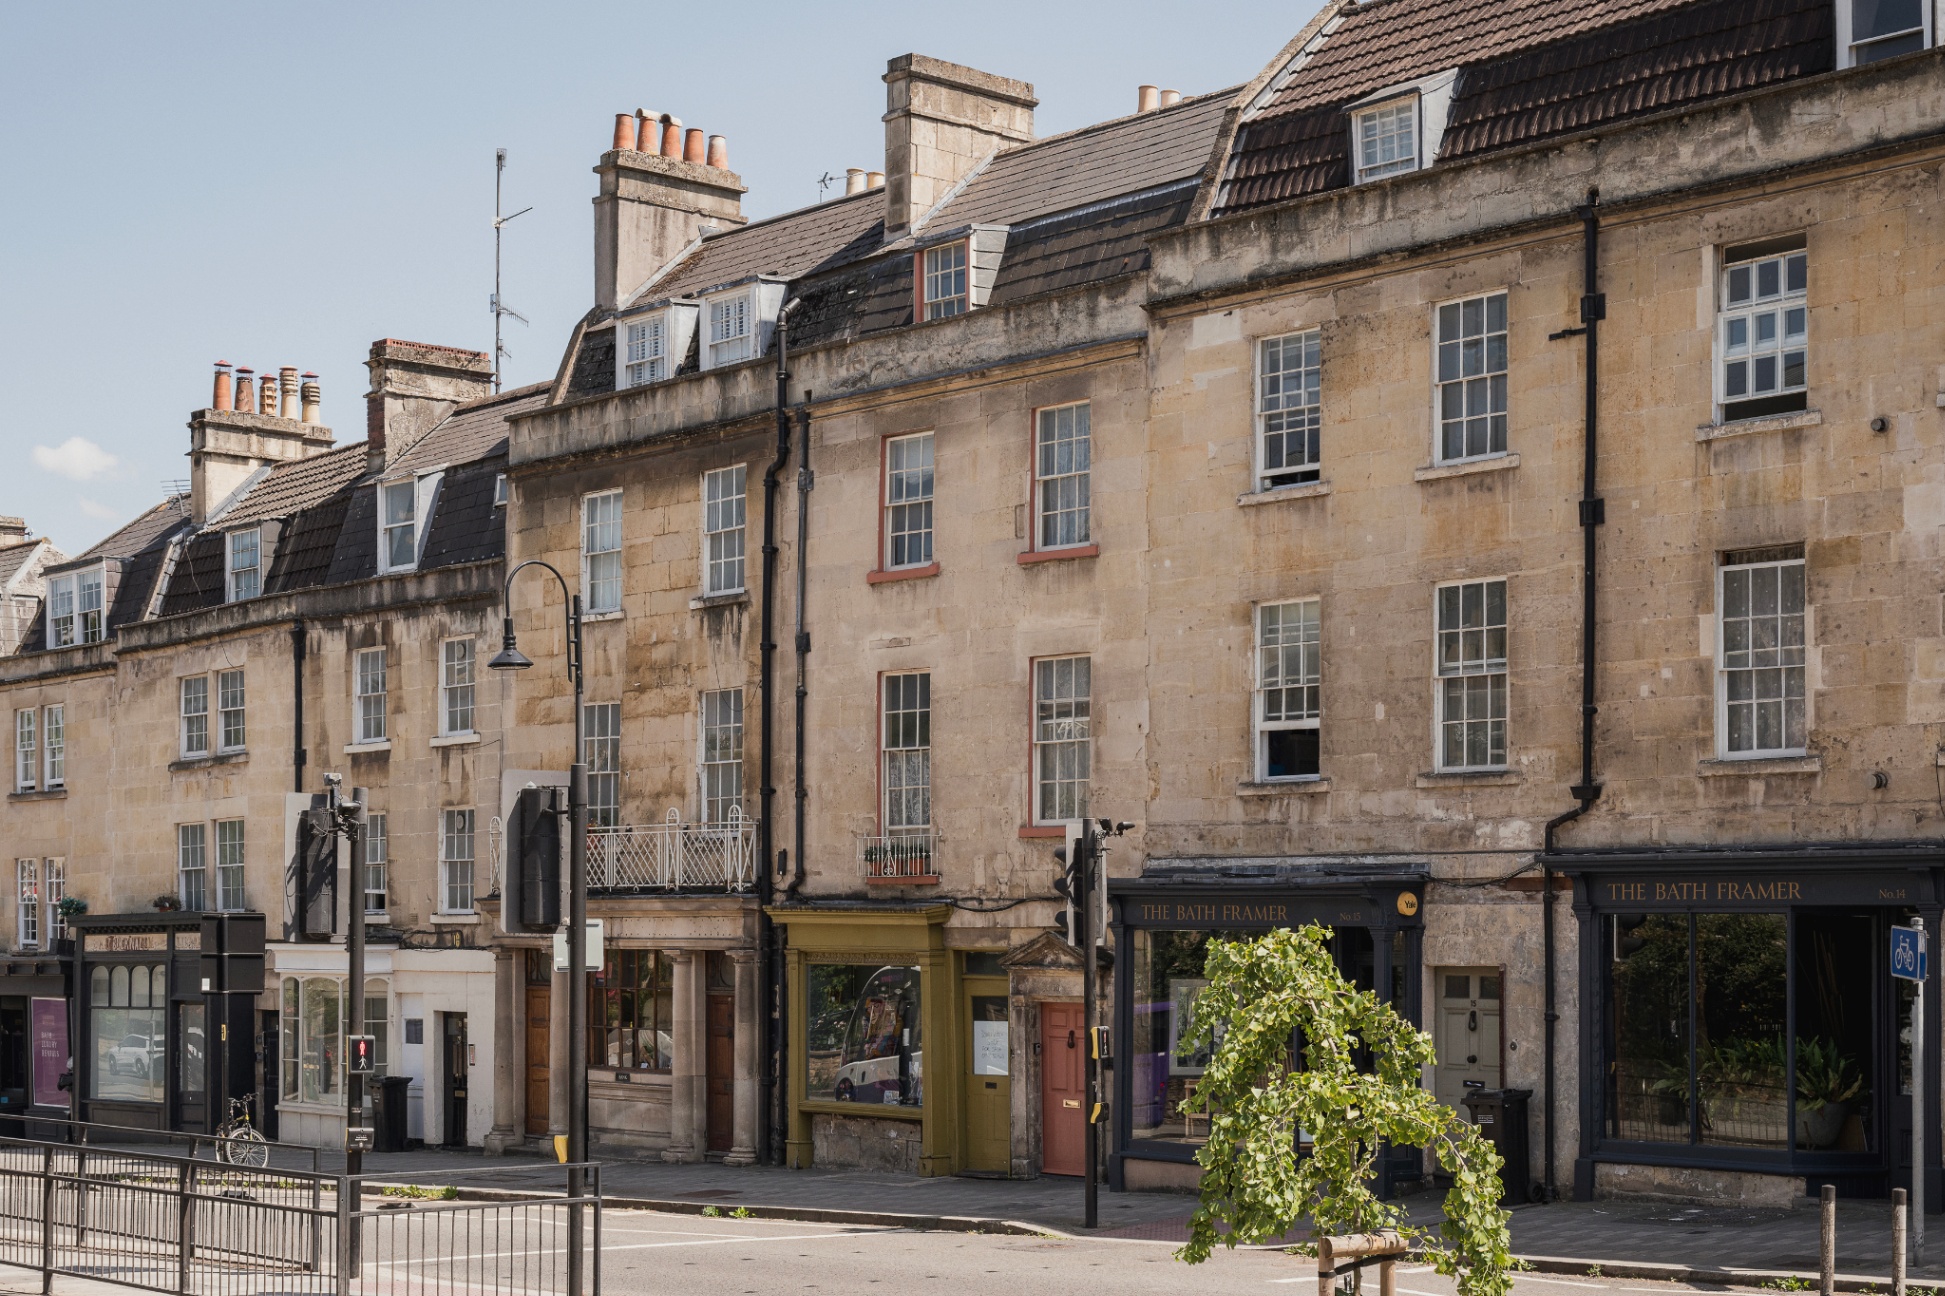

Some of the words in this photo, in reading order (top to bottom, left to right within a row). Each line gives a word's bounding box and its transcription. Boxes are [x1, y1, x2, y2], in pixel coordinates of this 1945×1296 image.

[1607, 883, 1646, 900] THE
[1655, 882, 1707, 900] BATH
[1716, 881, 1801, 900] FRAMER
[1141, 904, 1170, 921] THE
[1176, 904, 1216, 921] BATH
[1222, 904, 1288, 921] FRAMER
[1404, 900, 1416, 909] Yale
